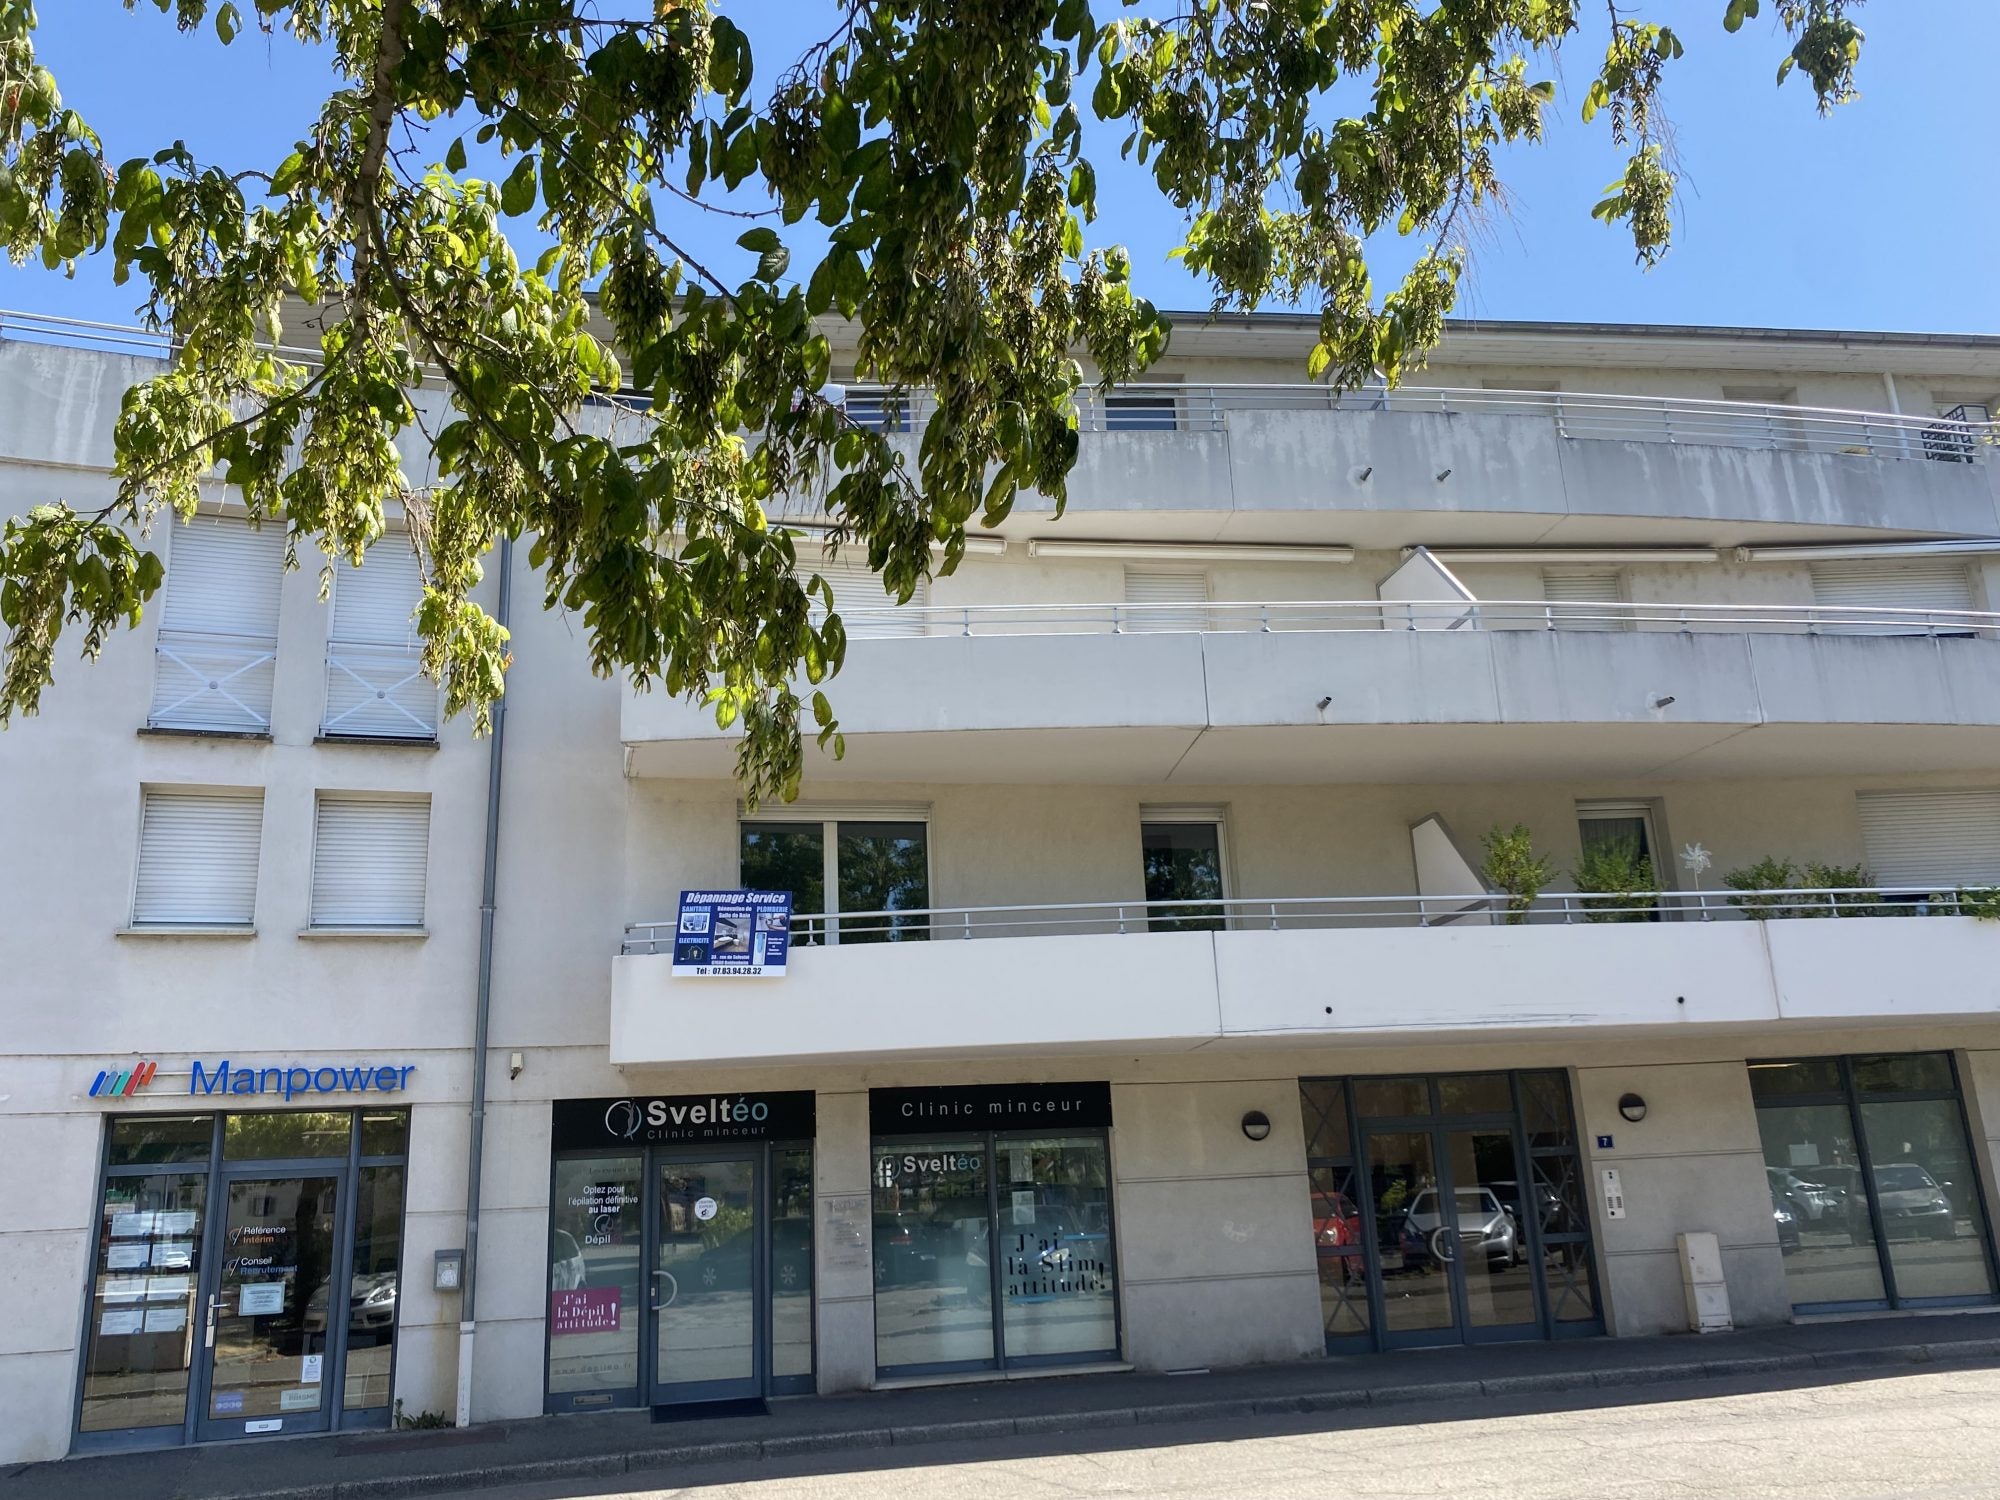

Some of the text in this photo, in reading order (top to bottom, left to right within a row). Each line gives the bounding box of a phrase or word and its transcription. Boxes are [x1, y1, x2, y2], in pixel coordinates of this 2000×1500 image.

[685, 892, 786, 904] Dépannage Service
[681, 905, 712, 913] SANITAIRE
[756, 905, 788, 913] PLOMBERIE
[696, 967, 707, 975] Tél
[190, 1060, 415, 1102] Manpower
[646, 1097, 769, 1126] Sveltéo
[902, 1099, 1082, 1117] Clinic minceur
[647, 1126, 767, 1140] Clinic minceur
[903, 1153, 981, 1173] Sveltéo
[583, 1185, 624, 1195] Optez pour
[568, 1195, 638, 1207] l'épilation définitive
[588, 1205, 620, 1214] au laser
[243, 1226, 286, 1235] Référence
[243, 1235, 274, 1244] Intérim
[1015, 1232, 1058, 1252] J'ai
[240, 1256, 273, 1266] Conseil
[1008, 1253, 1095, 1275] la Slim
[240, 1265, 298, 1275] Recrutement
[562, 1293, 587, 1305] J'ai
[557, 1303, 605, 1320] la Dépil
